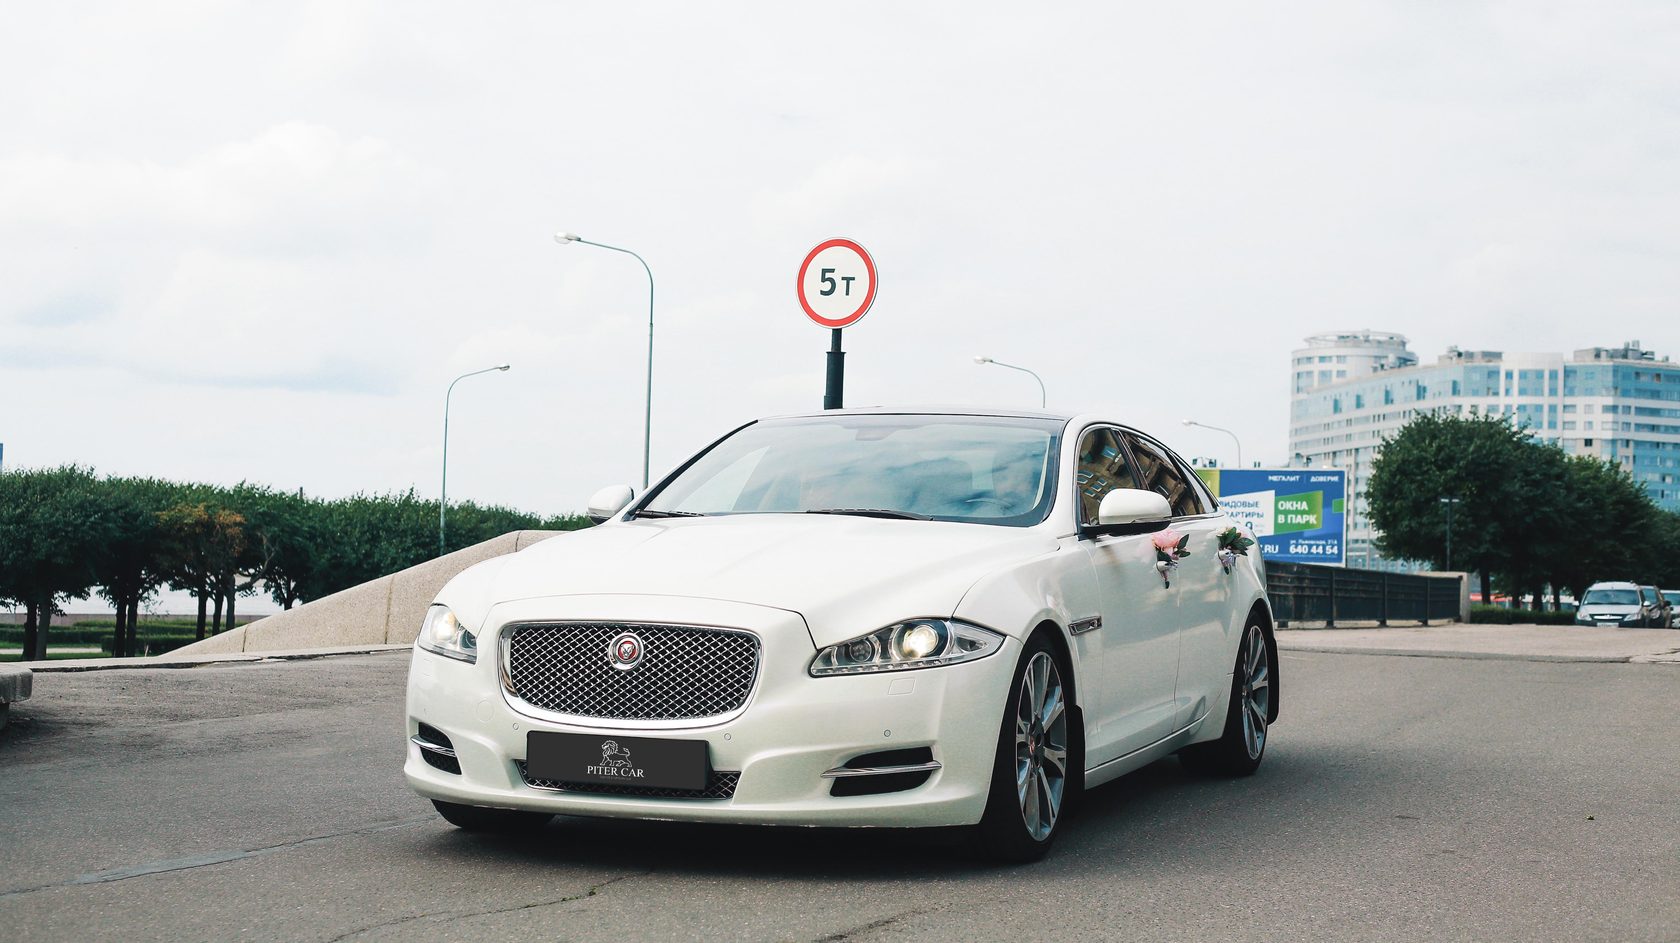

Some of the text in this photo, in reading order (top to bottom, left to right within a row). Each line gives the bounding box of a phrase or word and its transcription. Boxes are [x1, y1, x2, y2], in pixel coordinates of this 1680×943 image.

[1278, 500, 1308, 511] ОКНА
[1226, 511, 1264, 519] АРТИРЫ
[1278, 514, 1317, 524] В ПАРК
[1289, 544, 1338, 555] 640 44 54
[587, 765, 644, 778] PITER CAR
